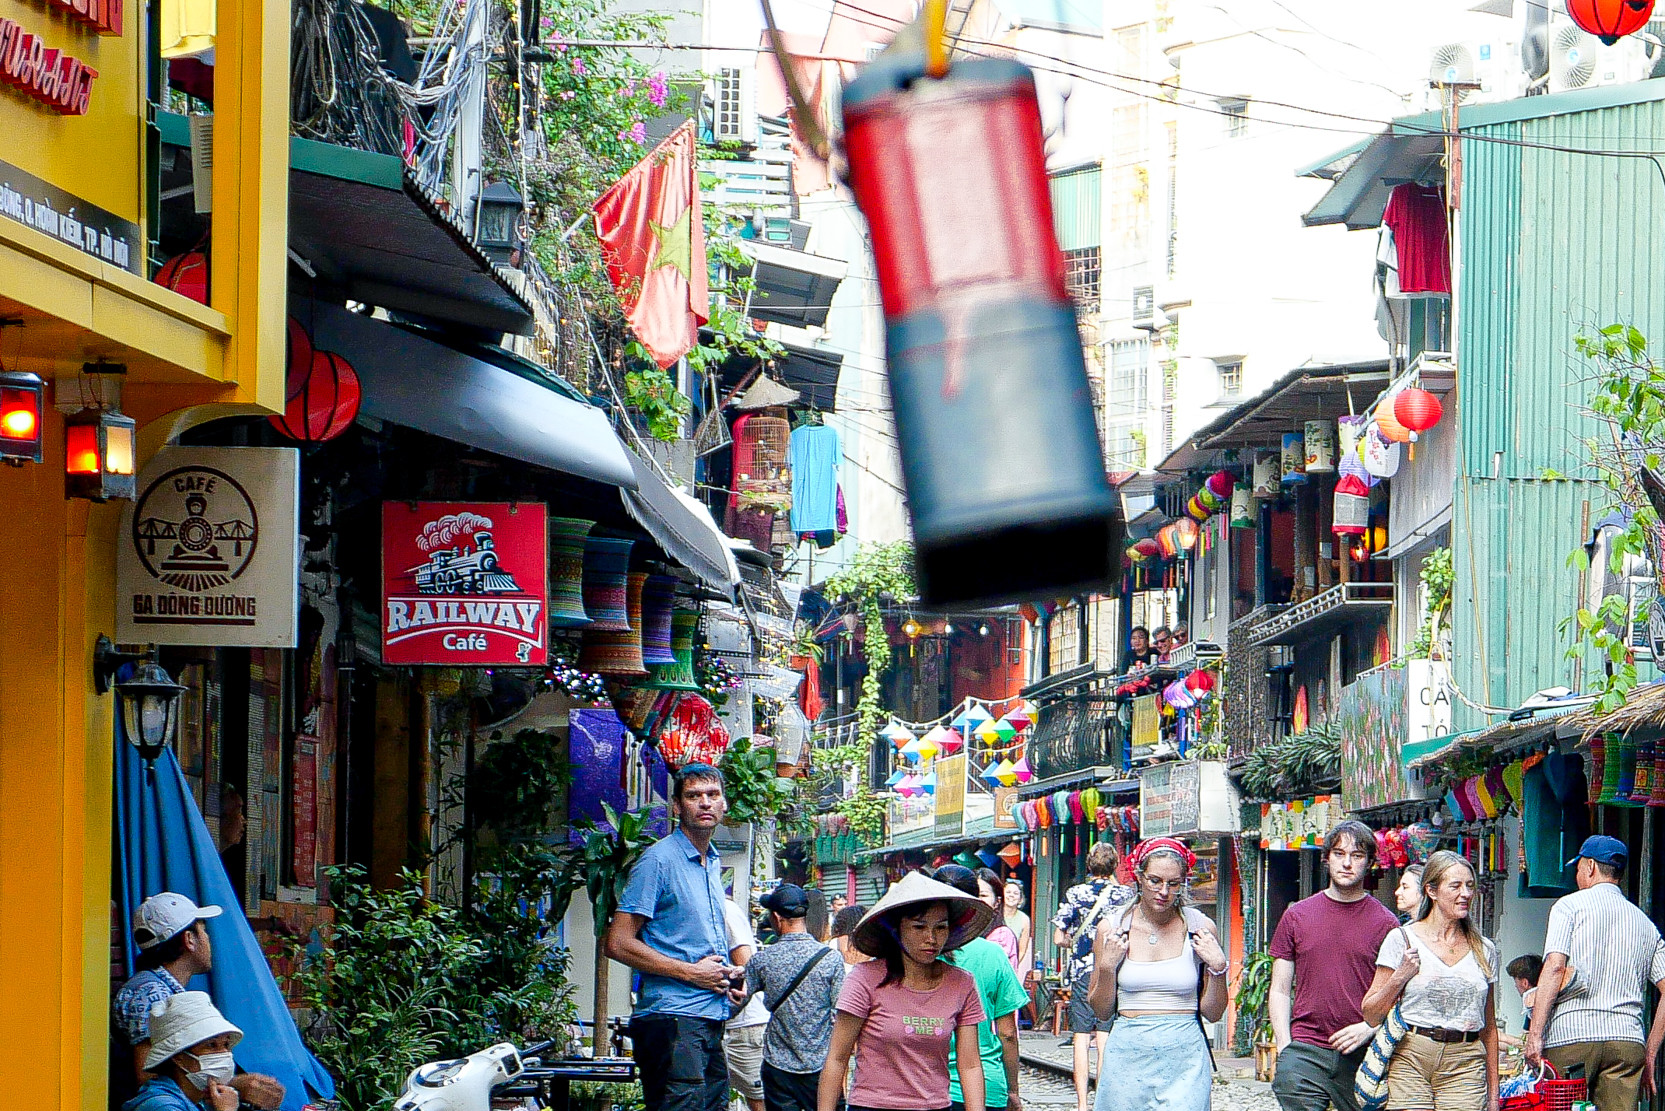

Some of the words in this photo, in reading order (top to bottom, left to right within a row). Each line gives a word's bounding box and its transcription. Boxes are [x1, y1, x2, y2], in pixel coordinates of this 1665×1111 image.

[174, 476, 218, 494] CAFÉ
[133, 594, 153, 614] GA
[387, 601, 541, 634] RAILWAY
[442, 632, 488, 651] Café
[902, 1015, 945, 1027] BERRY
[915, 1026, 934, 1036] ME
